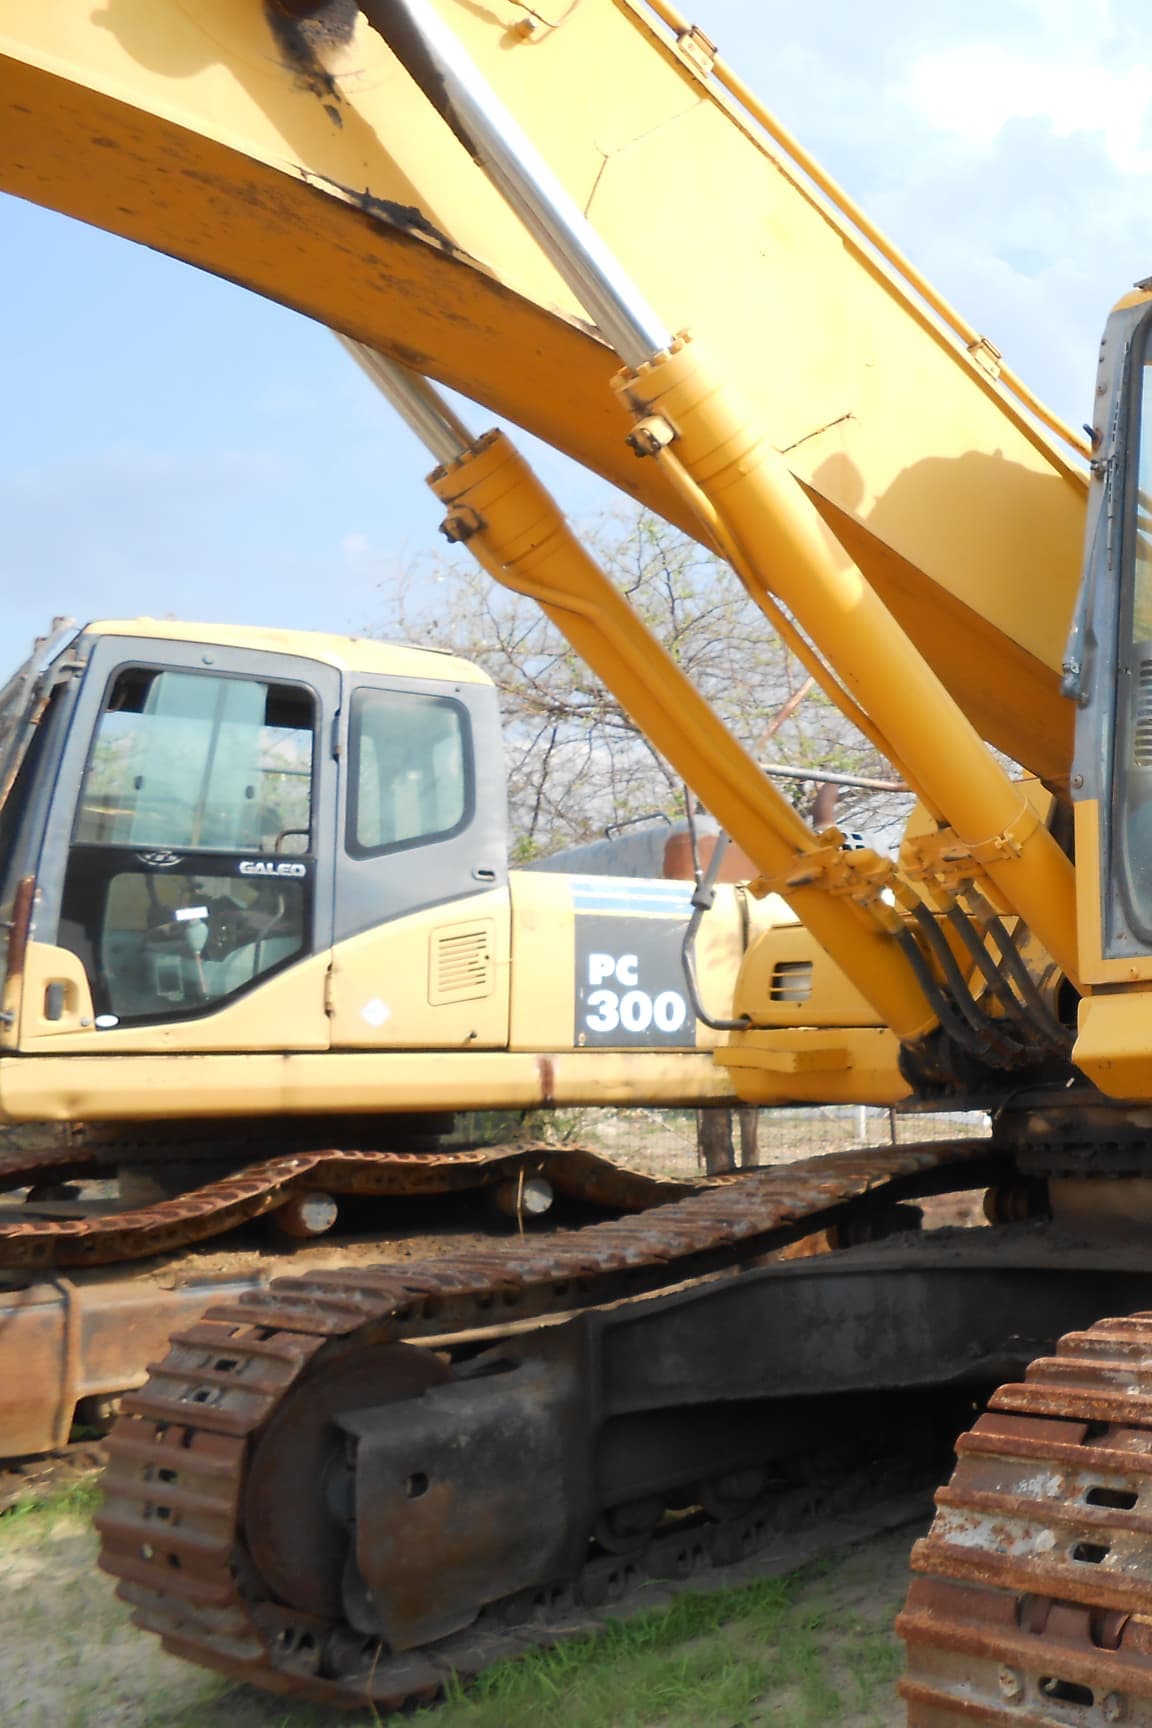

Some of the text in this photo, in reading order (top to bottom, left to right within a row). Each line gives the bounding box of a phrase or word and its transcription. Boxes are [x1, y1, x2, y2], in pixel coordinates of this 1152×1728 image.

[239, 861, 306, 877] GALEO
[588, 953, 639, 986] PC
[586, 989, 687, 1033] 300
